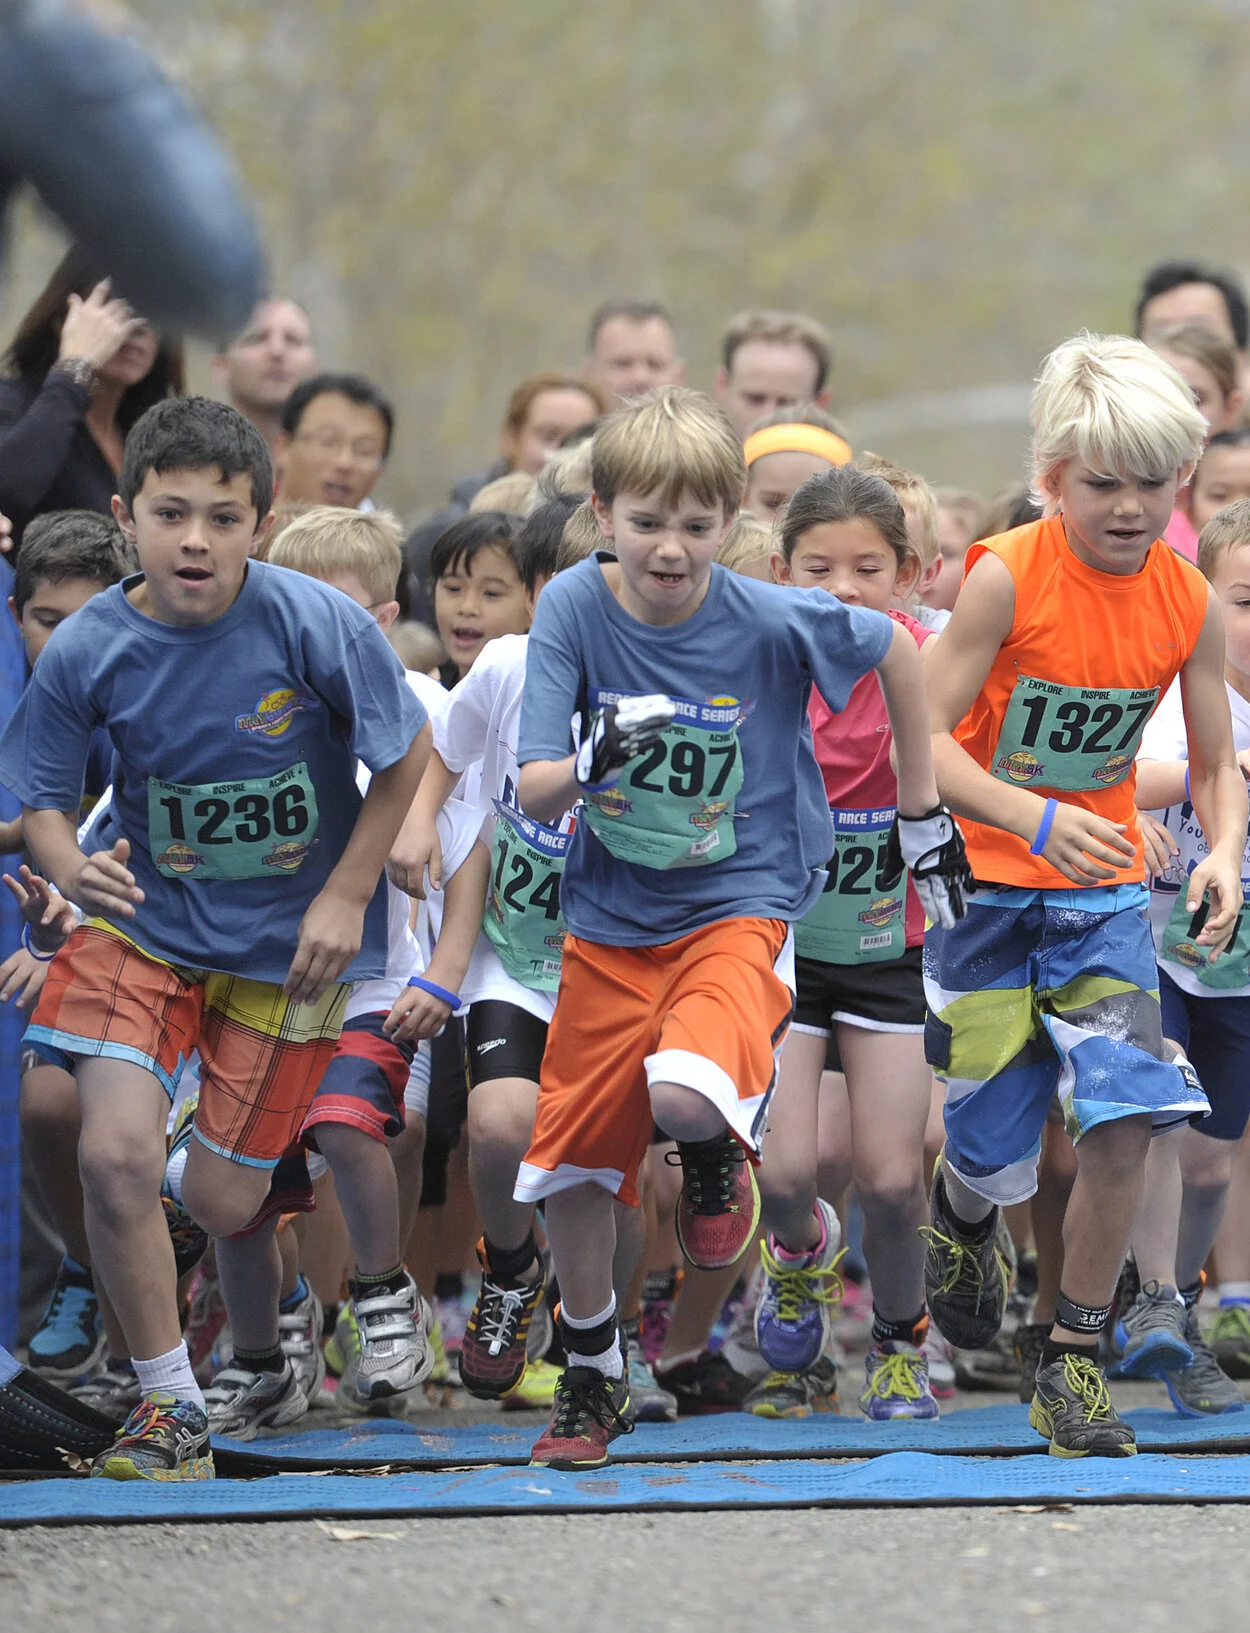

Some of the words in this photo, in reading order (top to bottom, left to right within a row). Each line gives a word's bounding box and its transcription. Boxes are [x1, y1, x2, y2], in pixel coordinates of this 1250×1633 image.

[1027, 679, 1064, 696] EXPLORE
[1080, 689, 1111, 700] INSPIRE
[1021, 695, 1155, 754] 1327
[159, 782, 193, 796] EXPLORE
[213, 782, 247, 795] INSPIRE
[268, 769, 296, 789] ACHIEVE
[630, 738, 737, 798] 297
[160, 784, 309, 845] 1236
[495, 838, 562, 921] 124
